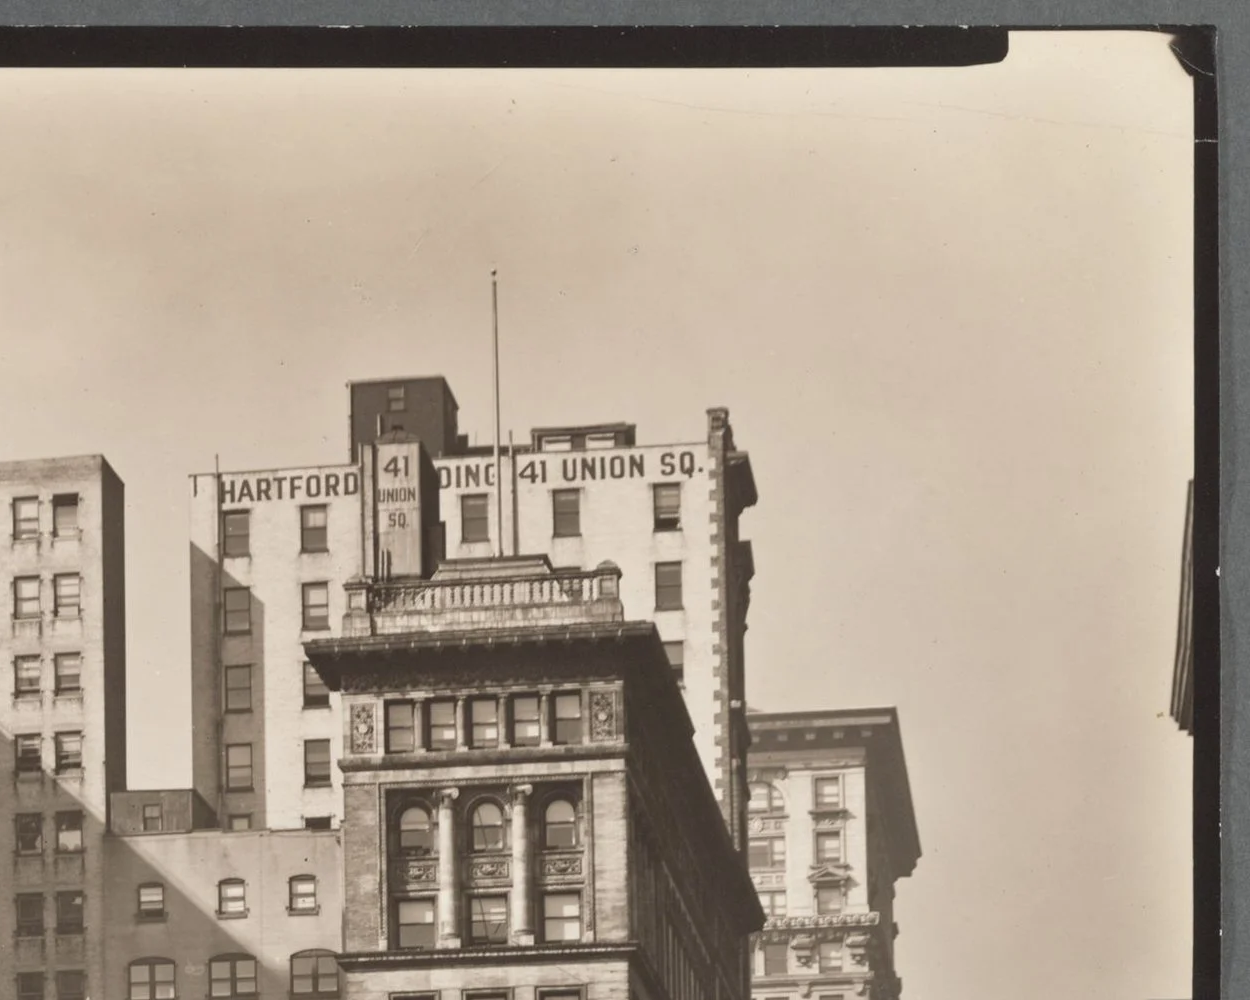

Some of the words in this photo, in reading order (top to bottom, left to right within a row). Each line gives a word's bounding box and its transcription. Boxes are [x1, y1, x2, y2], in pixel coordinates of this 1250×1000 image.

[384, 455, 411, 477] 41
[220, 473, 360, 504] HARTFORD
[437, 463, 495, 489] DING
[519, 460, 547, 484] 41
[562, 454, 646, 481] UNION
[378, 485, 417, 504] UNION
